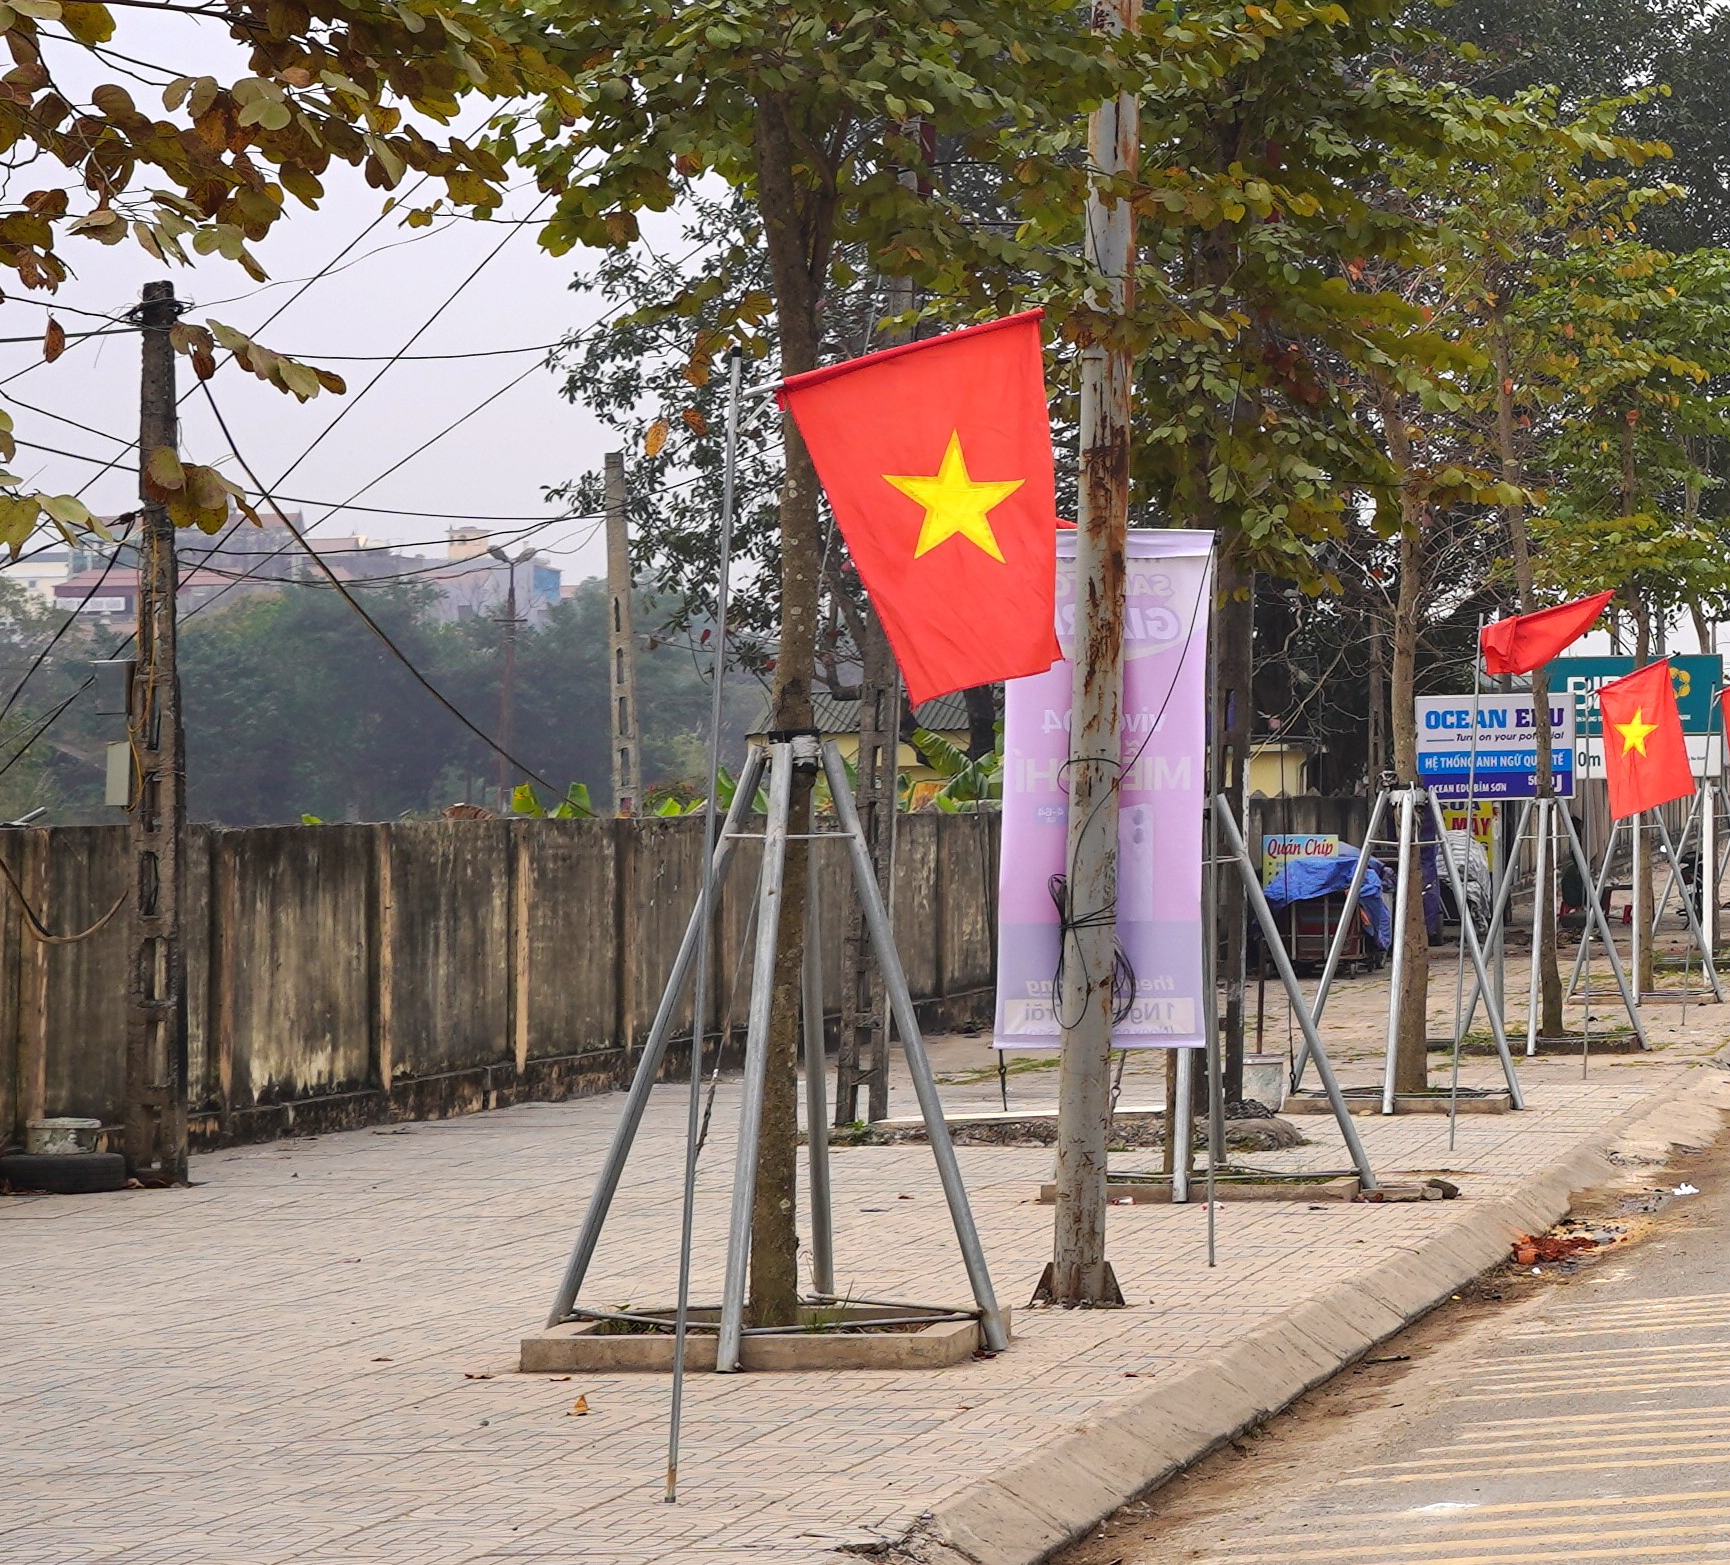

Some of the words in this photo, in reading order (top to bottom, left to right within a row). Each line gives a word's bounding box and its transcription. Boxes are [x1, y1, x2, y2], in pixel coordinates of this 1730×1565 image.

[1425, 708, 1507, 729] OCEAN
[1494, 733, 1516, 745] your
[1425, 755, 1439, 772] HỆ
[1476, 756, 1498, 767] ANH
[1267, 838, 1301, 859] Quán
